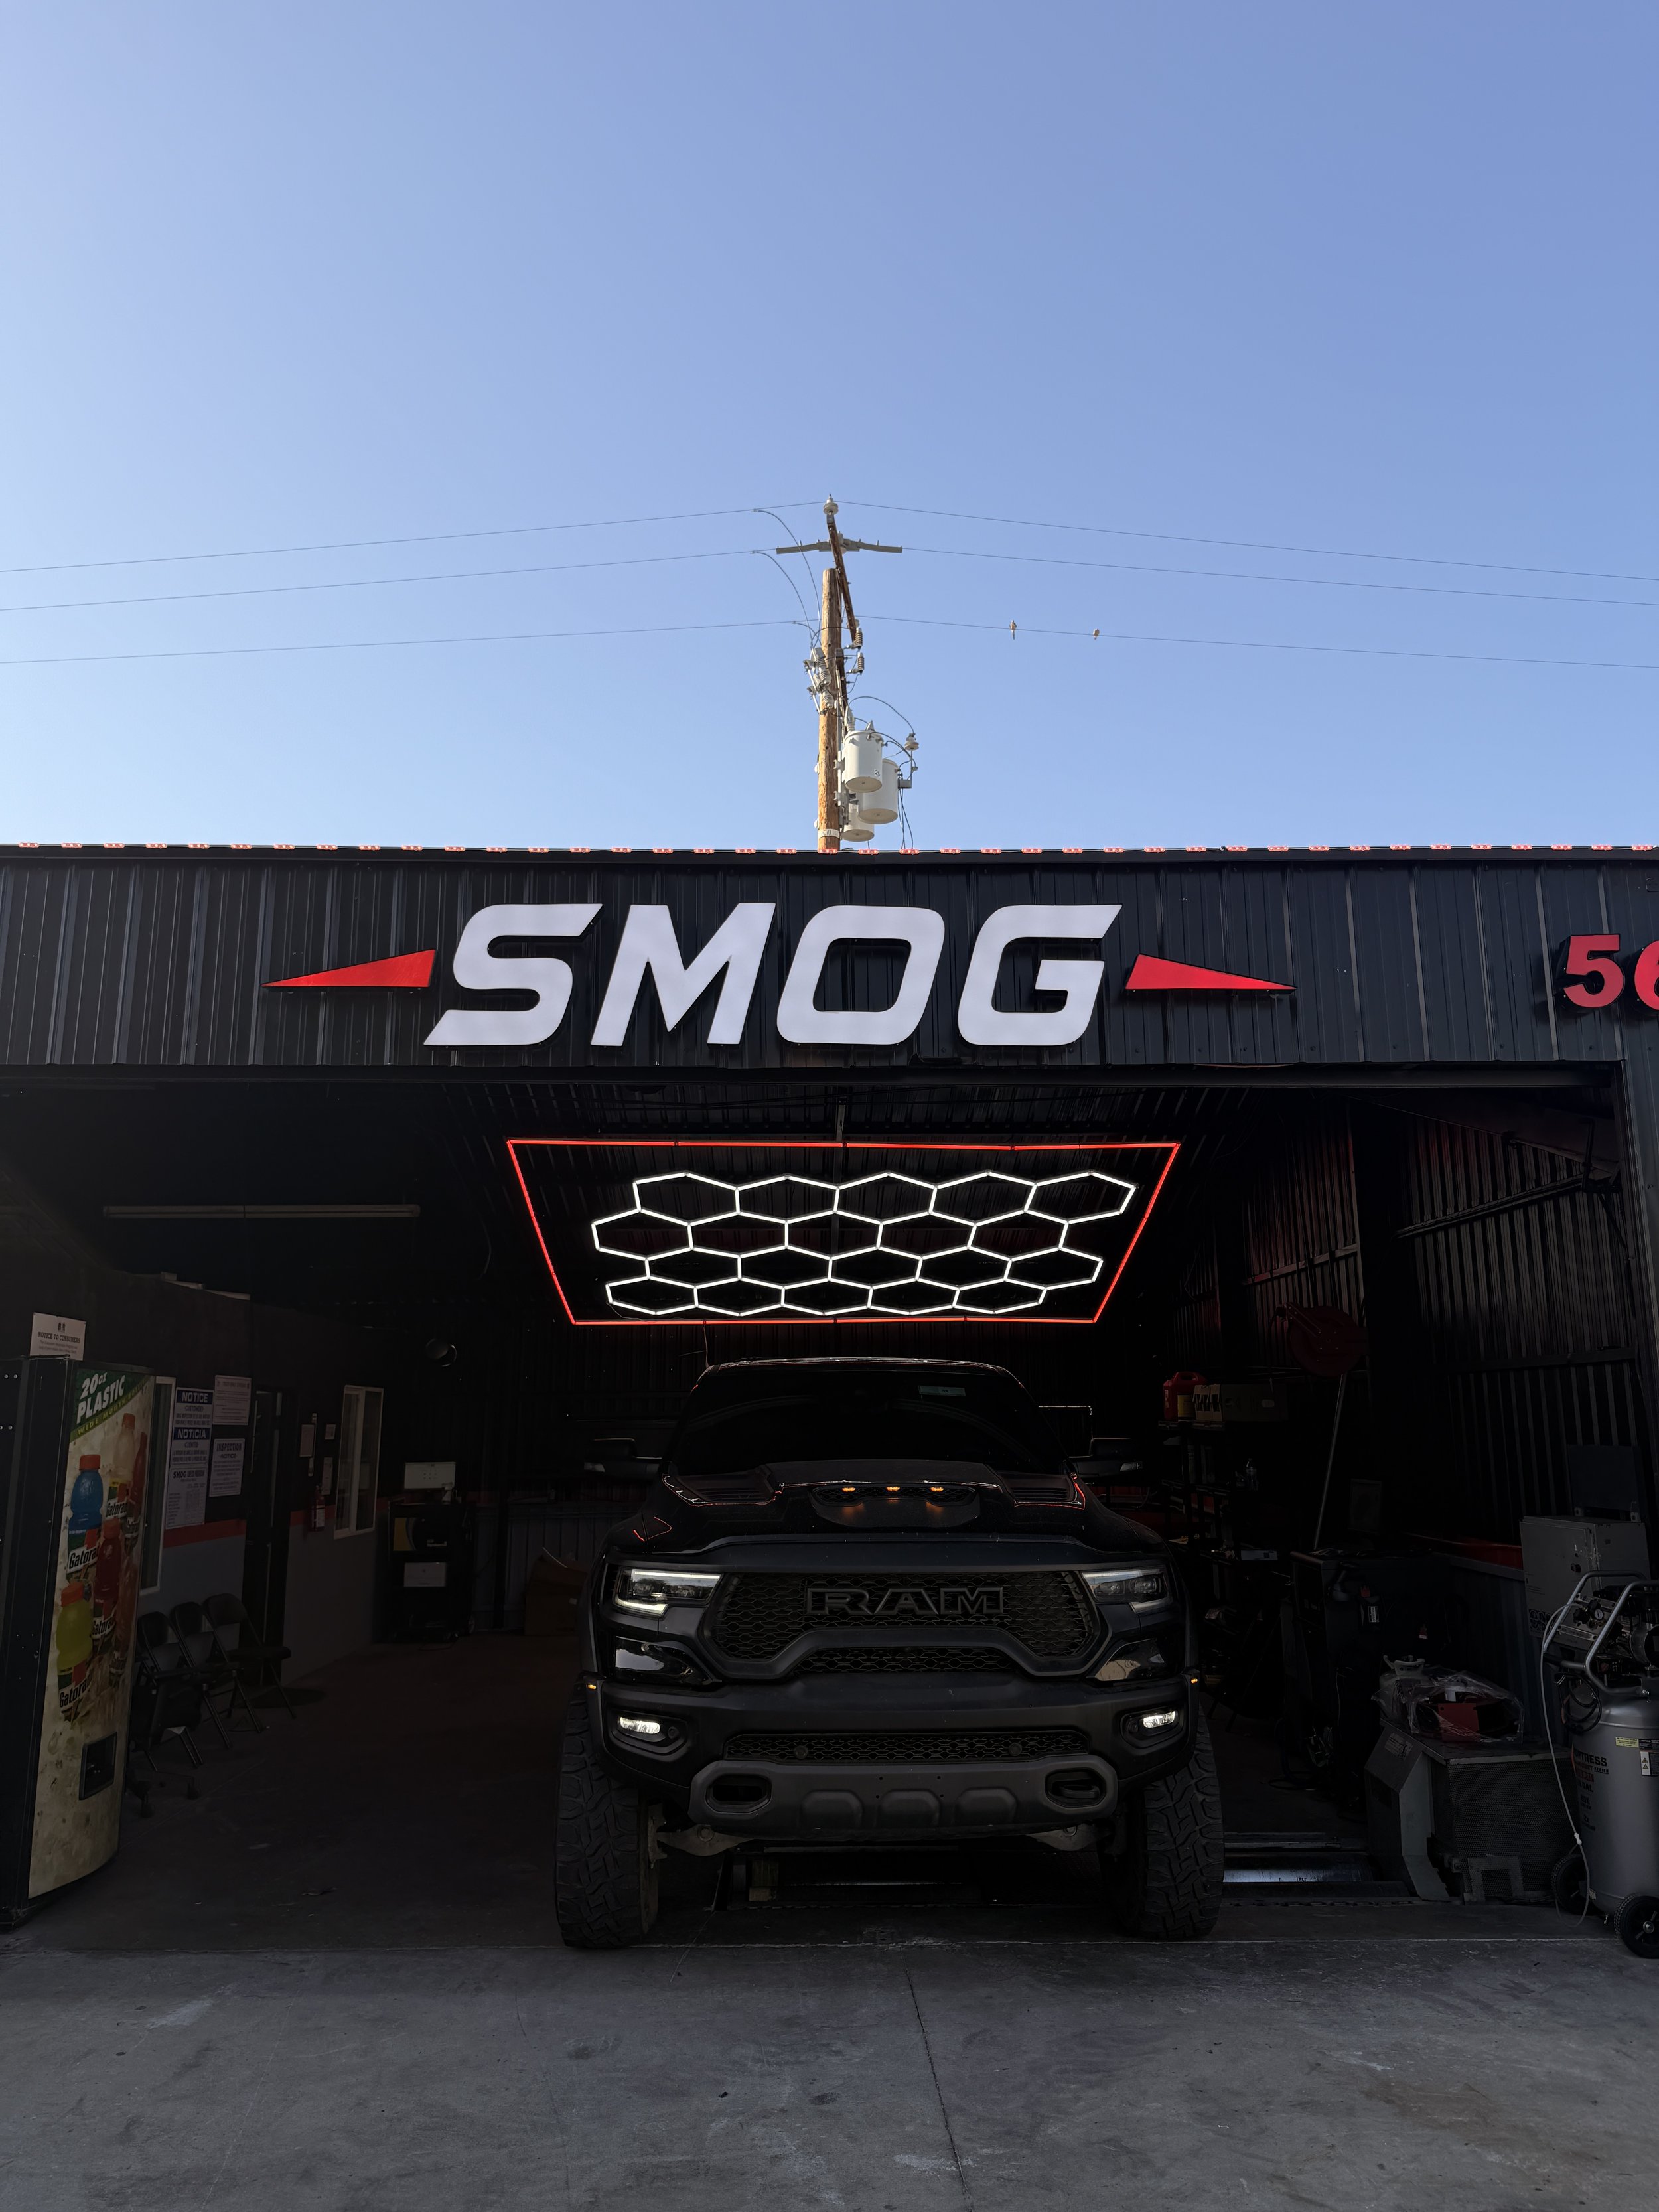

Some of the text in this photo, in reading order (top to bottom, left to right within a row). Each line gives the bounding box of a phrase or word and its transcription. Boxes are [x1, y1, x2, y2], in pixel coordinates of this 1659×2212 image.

[424, 903, 1121, 1045] SMOG
[76, 1374, 125, 1424] PLASTIC
[182, 1392, 208, 1402] NOTICE
[177, 1429, 206, 1439] NOTICIA
[216, 1443, 242, 1451] INSPECTION
[806, 1587, 1003, 1616] RAM
